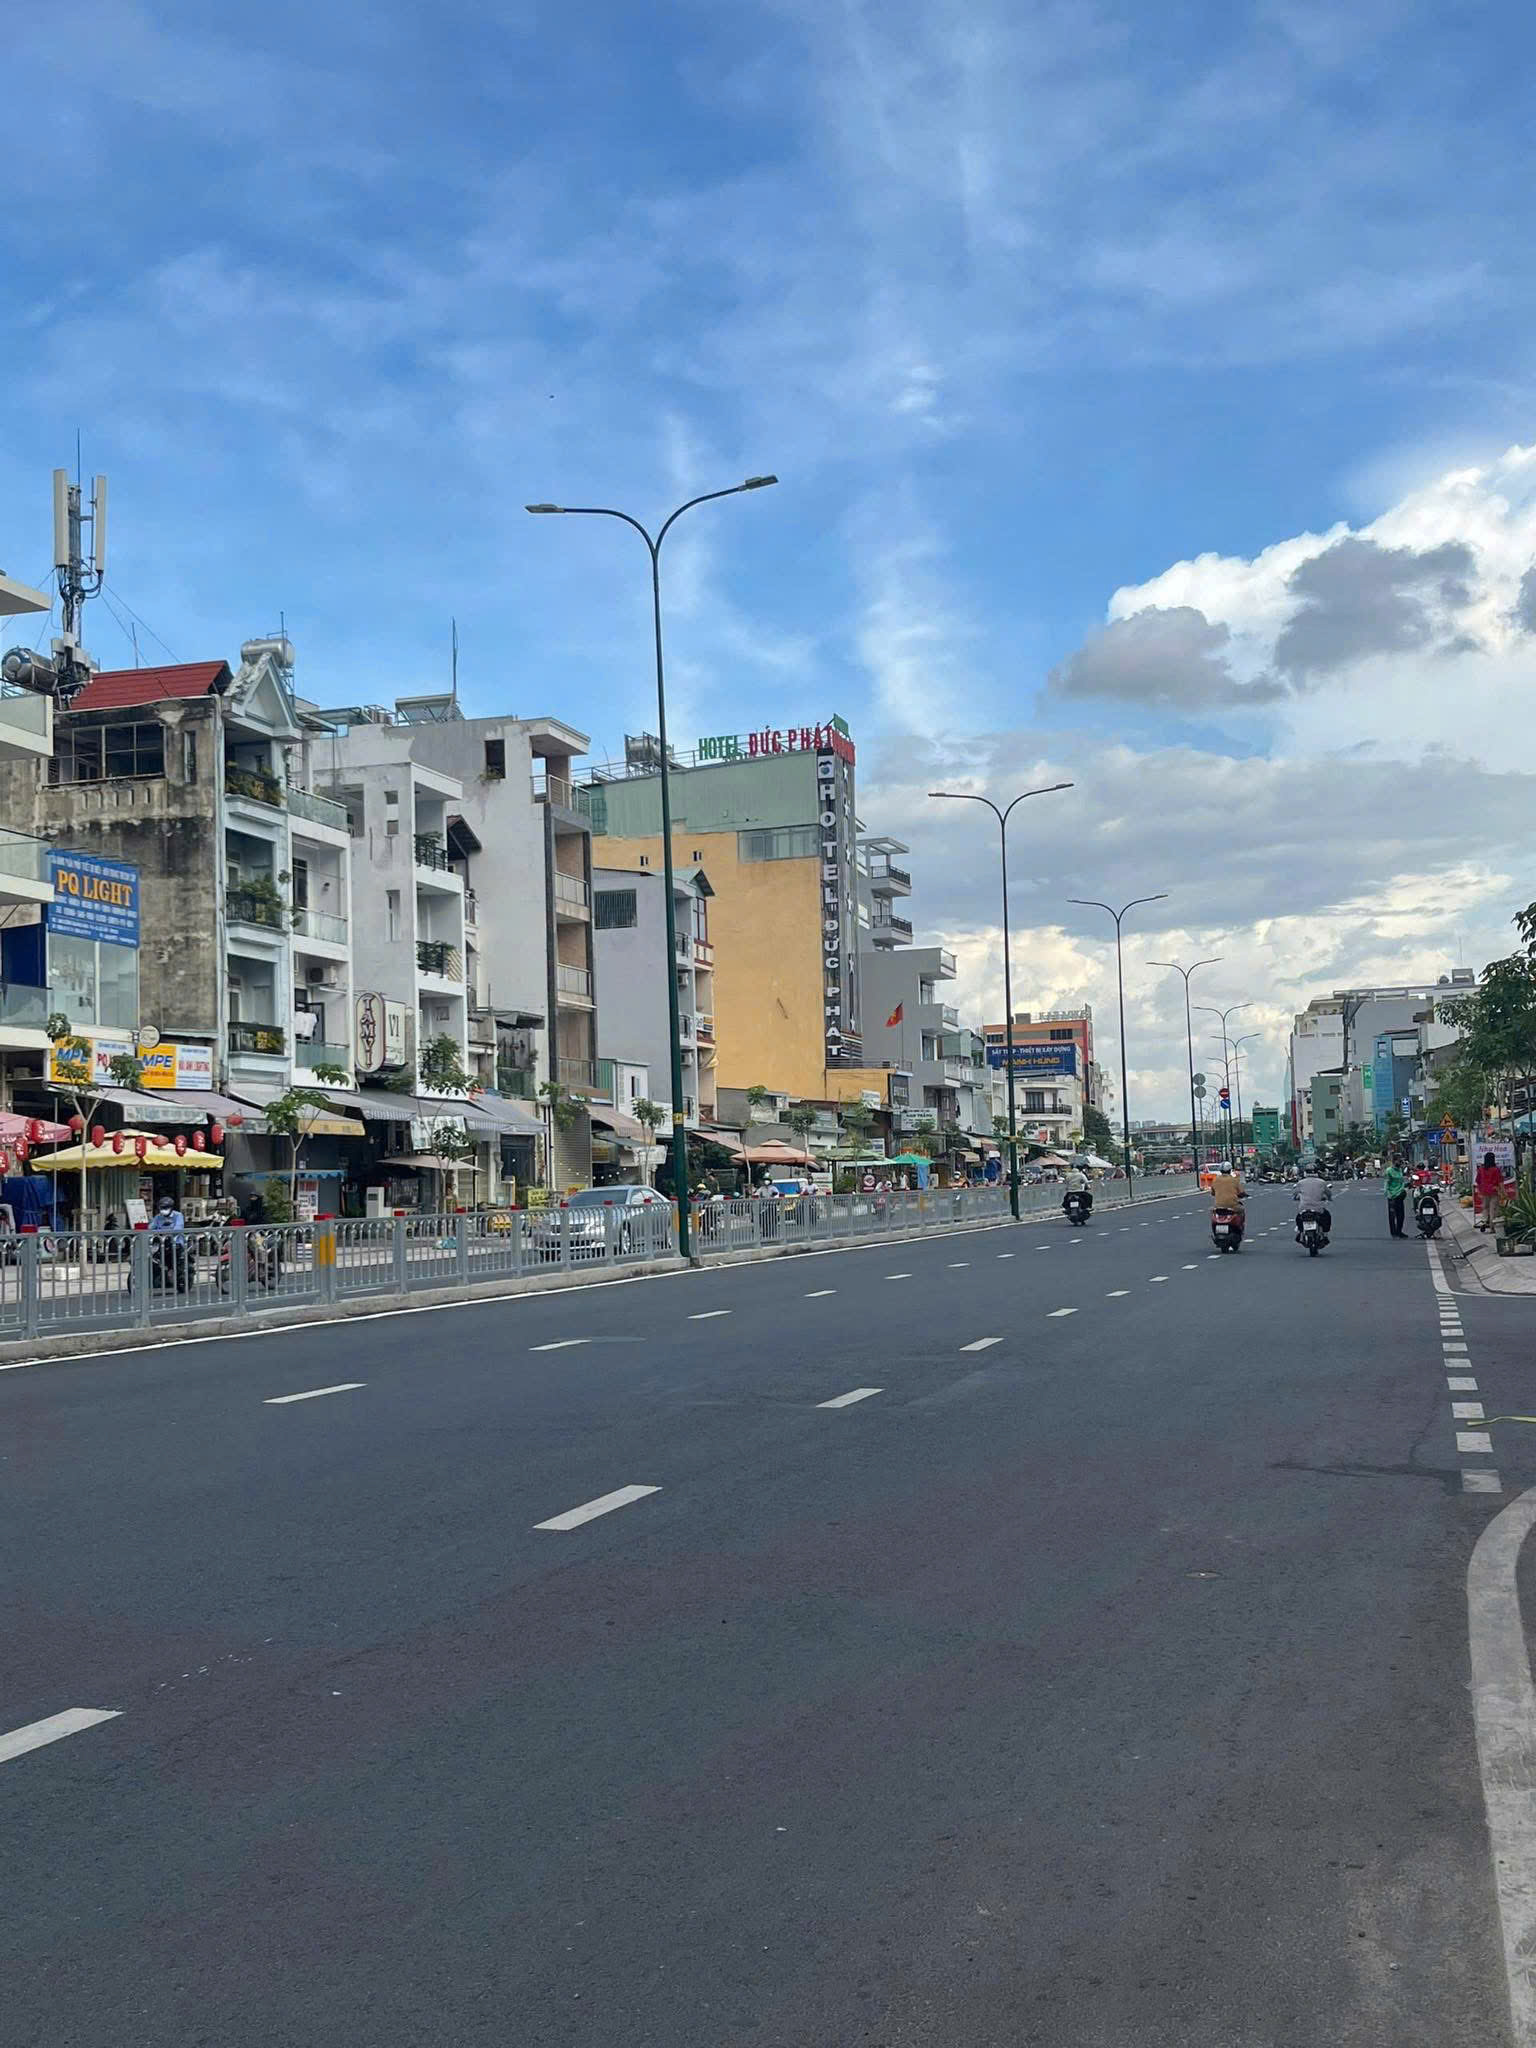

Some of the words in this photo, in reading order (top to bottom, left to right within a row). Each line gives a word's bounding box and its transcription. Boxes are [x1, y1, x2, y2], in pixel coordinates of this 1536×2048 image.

[698, 735, 739, 761] HOTEL
[748, 725, 781, 757] ĐỨC
[787, 722, 832, 753] PHÁT
[820, 783, 838, 904] HOTEL
[82, 875, 133, 907] LIGHT
[824, 920, 840, 969] ĐỨC
[825, 986, 841, 1055] PHÁT
[142, 1052, 174, 1068] MPE
